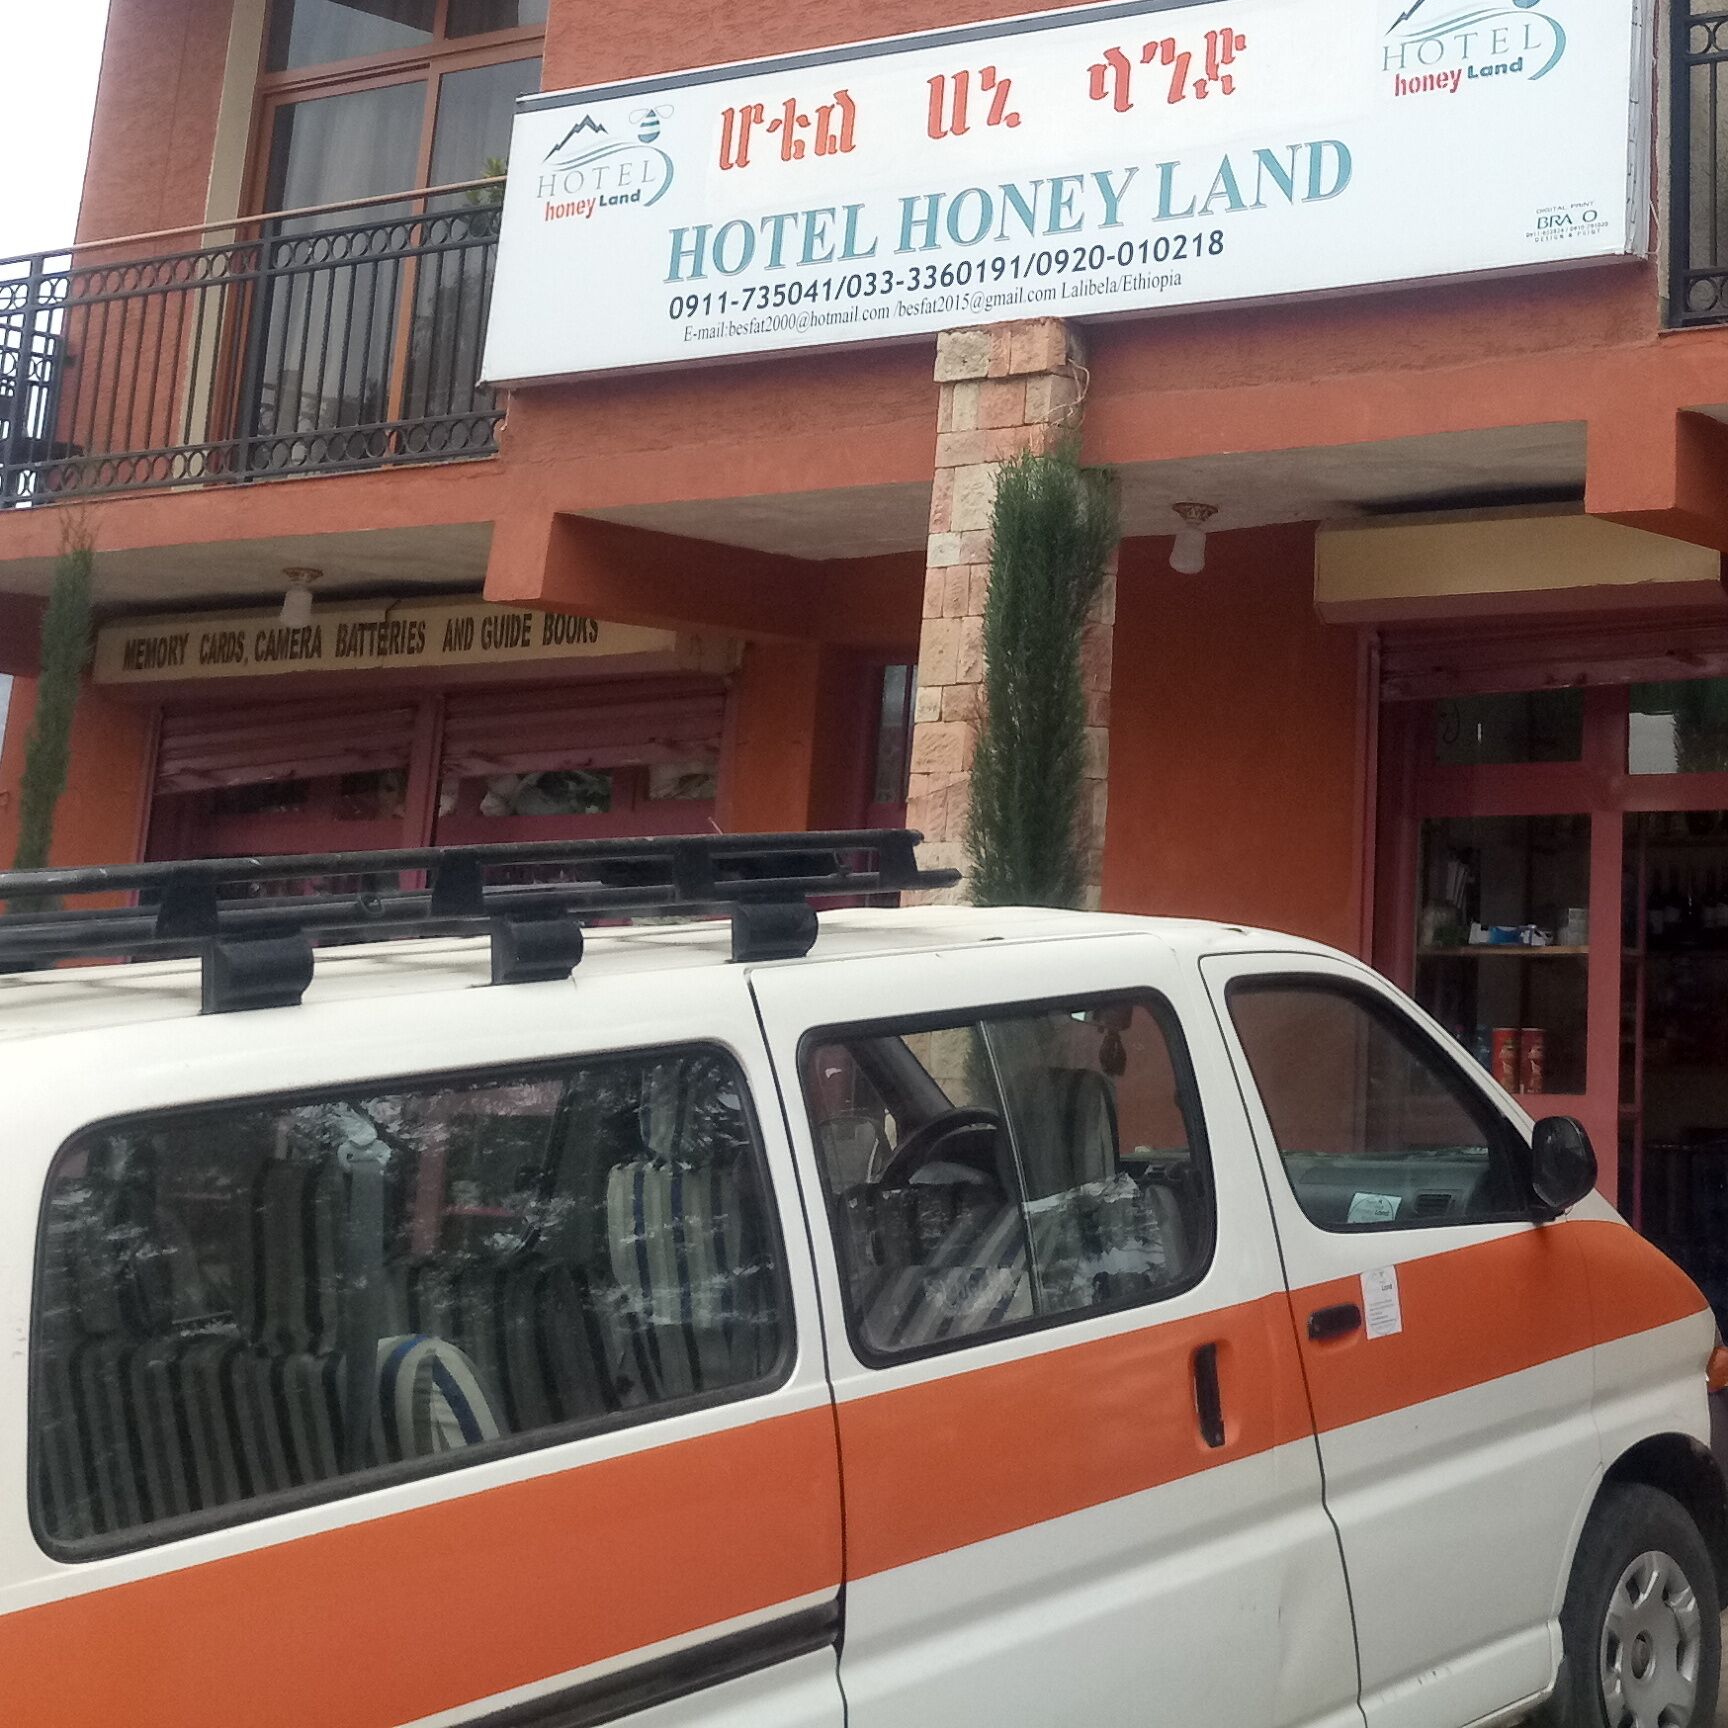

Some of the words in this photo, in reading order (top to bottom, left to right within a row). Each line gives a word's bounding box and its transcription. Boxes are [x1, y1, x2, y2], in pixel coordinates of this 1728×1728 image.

[1382, 24, 1542, 71] HOTEL
[1394, 68, 1463, 97] honey
[1467, 57, 1524, 79] Land
[536, 160, 658, 198] HOTEL
[544, 198, 597, 221] honey
[599, 189, 642, 207] Land
[663, 203, 880, 284] HOTEL
[892, 166, 1140, 255] HONEY
[1151, 139, 1354, 224] LAND
[669, 229, 1225, 320] 0911-735041/033-3360191/0920-010218
[1060, 269, 1182, 299] Lalibela/Ethiopia
[122, 633, 190, 670] MEMORY
[200, 631, 249, 667] CARDS,
[254, 624, 322, 662] CAMERA
[335, 620, 426, 658] BATTERIES
[442, 616, 475, 652] AND
[480, 612, 533, 650] GUIDE
[541, 611, 599, 646] BOOKS
